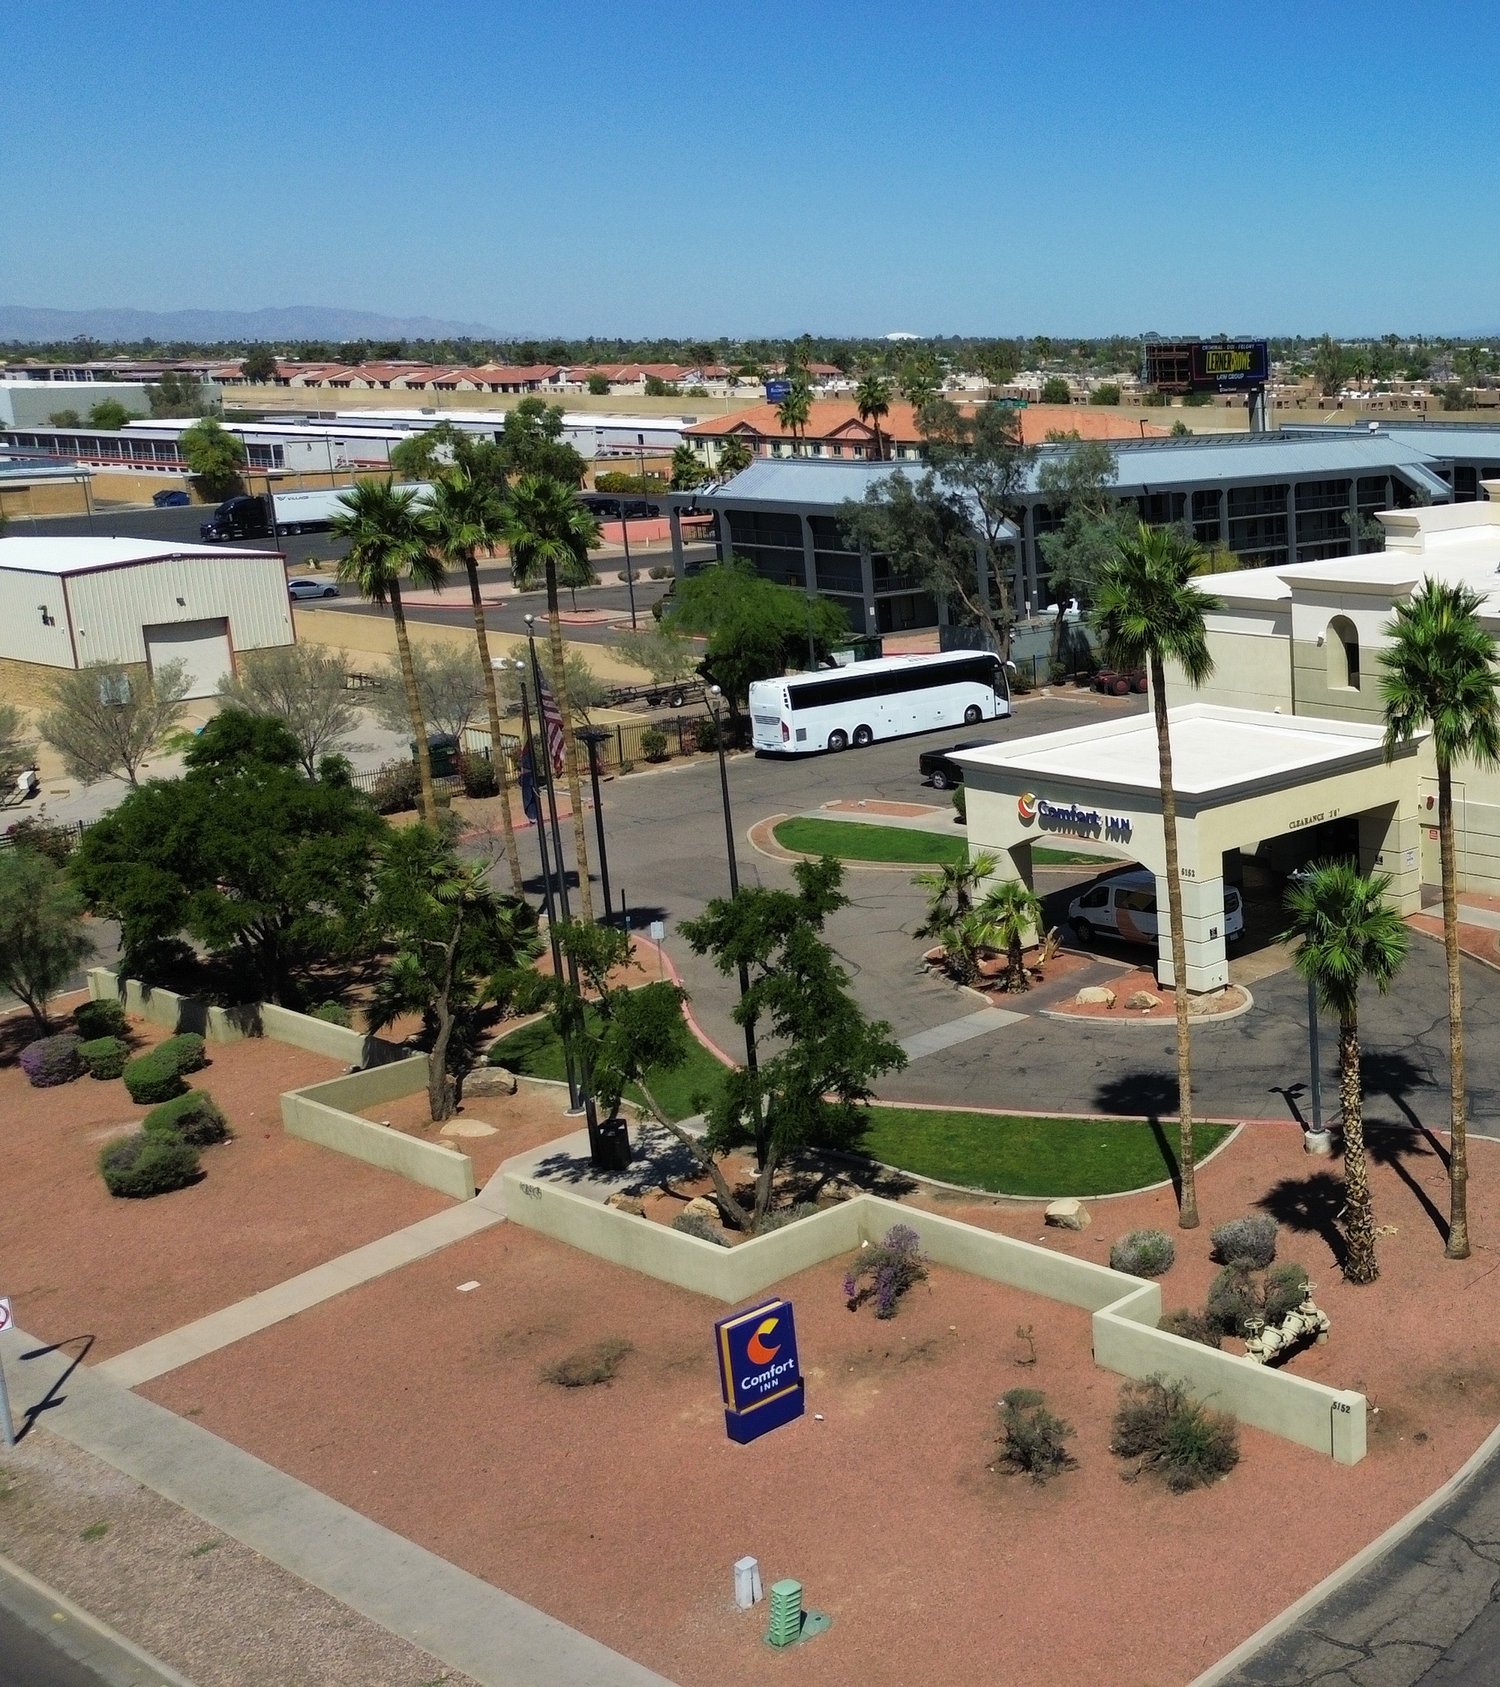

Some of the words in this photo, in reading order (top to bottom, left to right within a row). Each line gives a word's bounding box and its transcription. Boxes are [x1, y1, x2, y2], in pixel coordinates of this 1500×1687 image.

[1037, 800, 1102, 826] Comfort
[1105, 815, 1133, 831] INN
[1288, 812, 1325, 829] CLEARANCE
[741, 1358, 795, 1391] Comfort
[759, 1377, 780, 1393] INN
[1331, 1401, 1351, 1414] 5152
